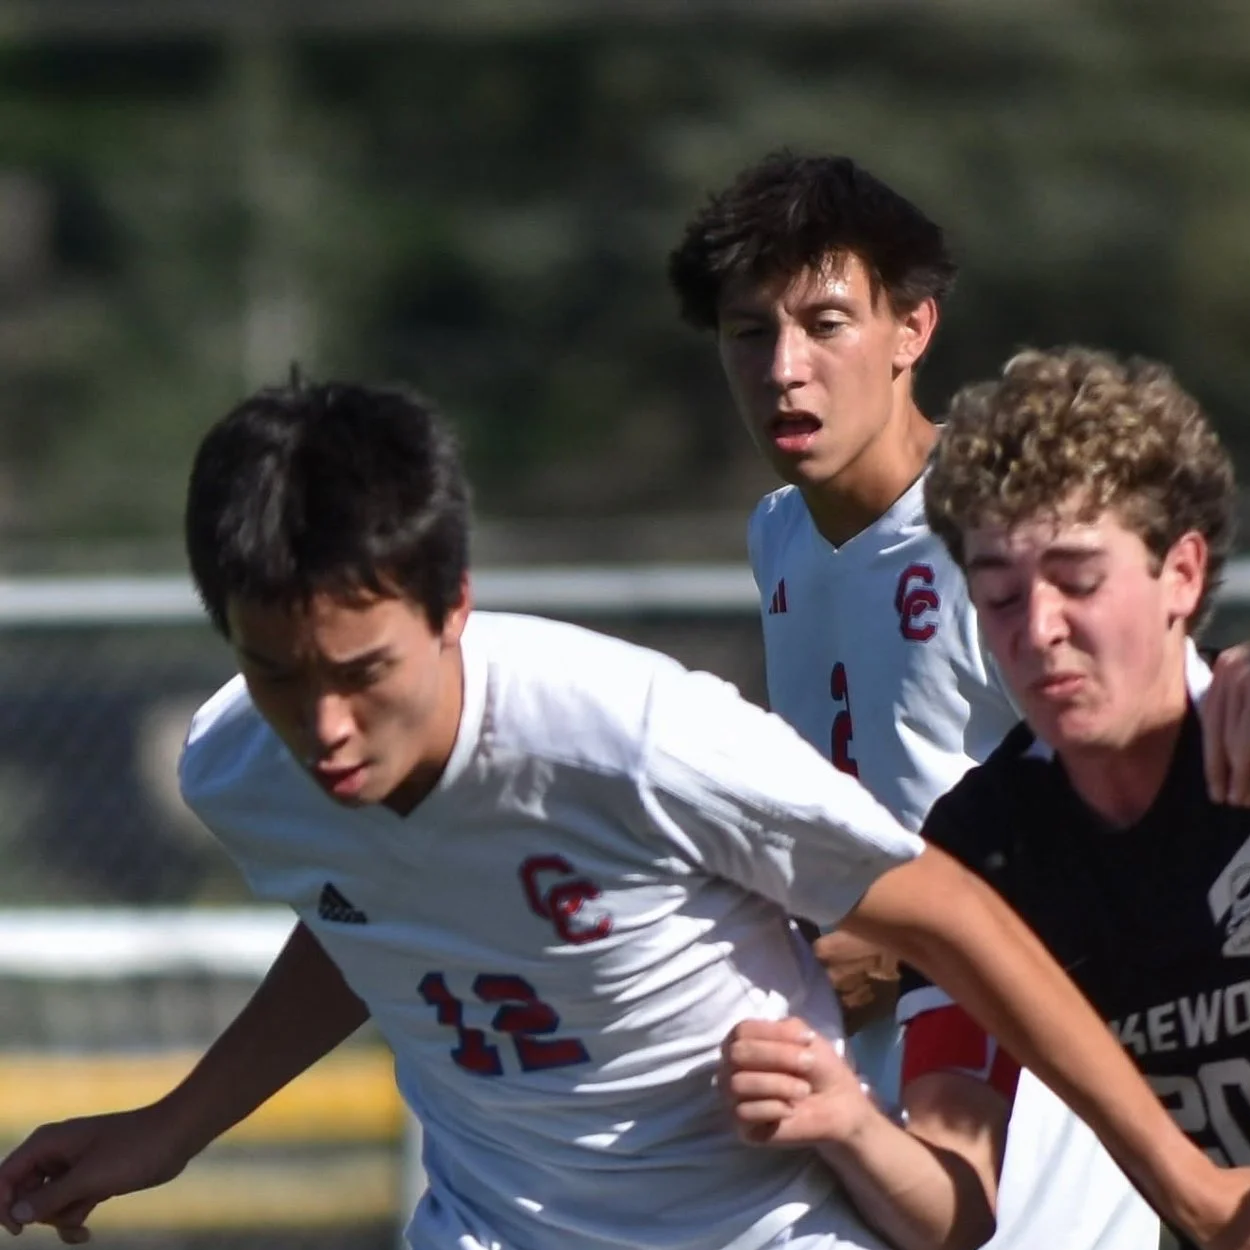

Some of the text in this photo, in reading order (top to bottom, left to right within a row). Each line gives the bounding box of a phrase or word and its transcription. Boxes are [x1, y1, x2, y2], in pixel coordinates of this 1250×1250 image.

[895, 562, 942, 643] CC
[519, 853, 614, 944] CC
[417, 972, 592, 1076] 12
